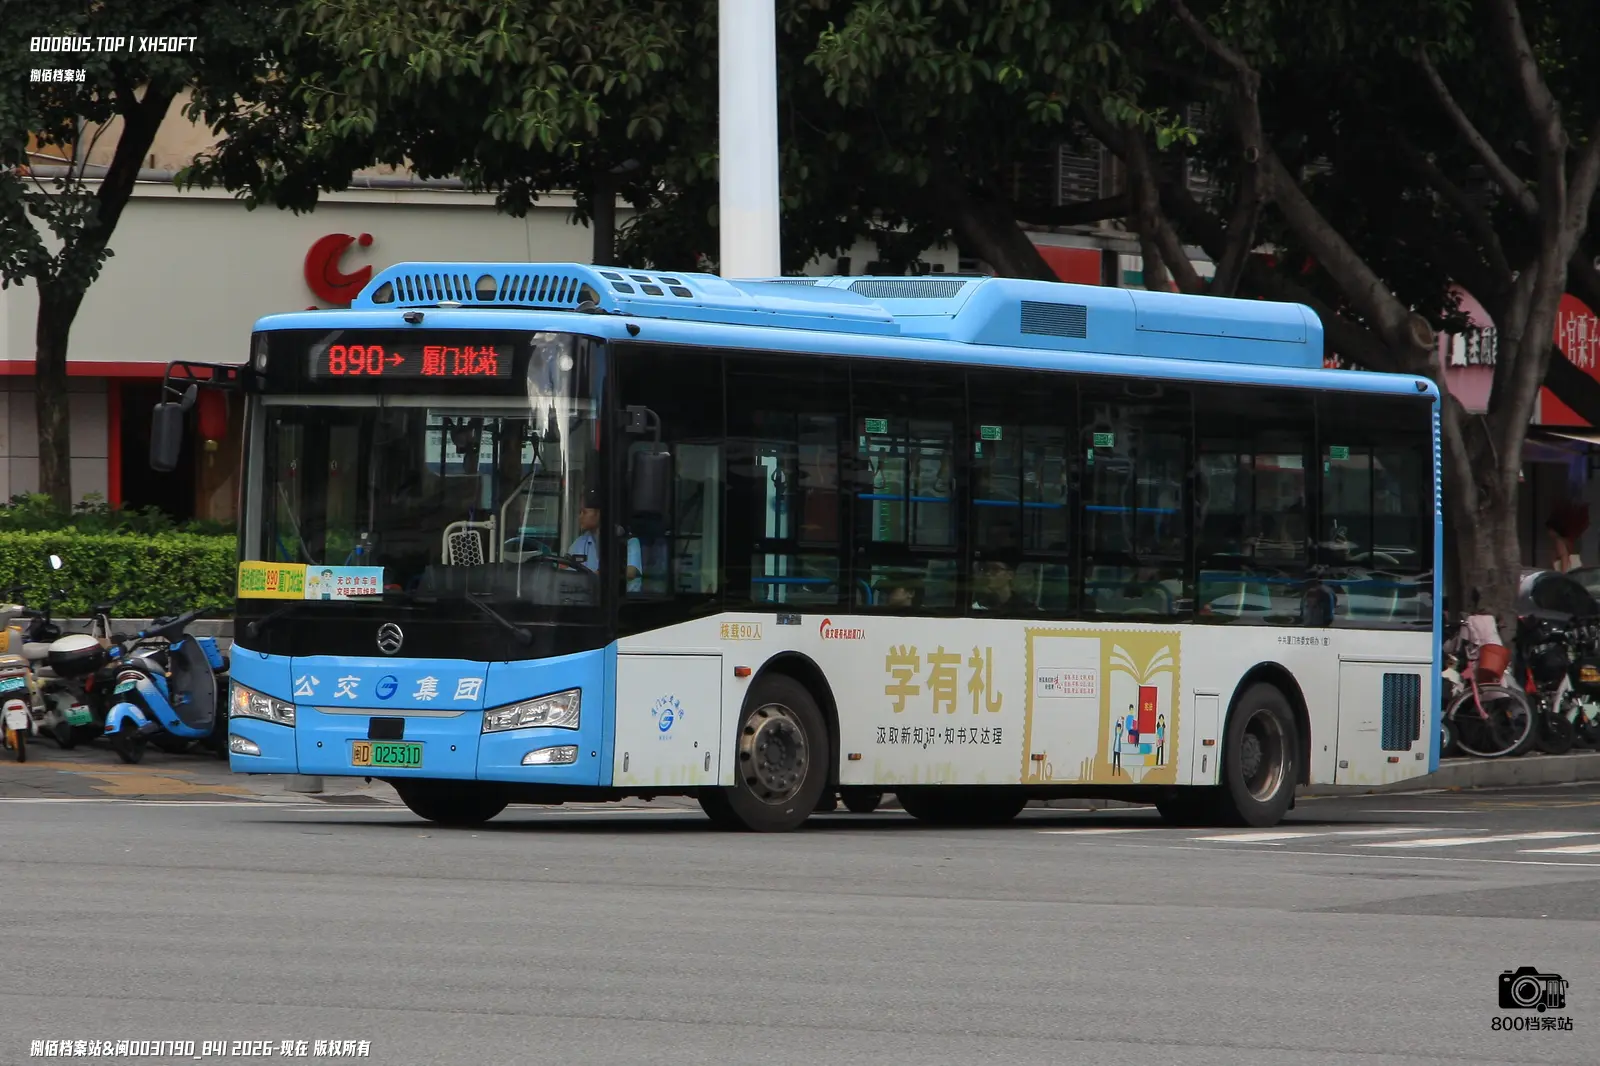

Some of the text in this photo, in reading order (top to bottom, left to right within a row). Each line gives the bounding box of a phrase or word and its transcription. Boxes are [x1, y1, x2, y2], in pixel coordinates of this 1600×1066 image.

[329, 345, 499, 376] 890 厦门北站
[267, 570, 279, 585] 890
[884, 644, 1003, 715] 学有礼
